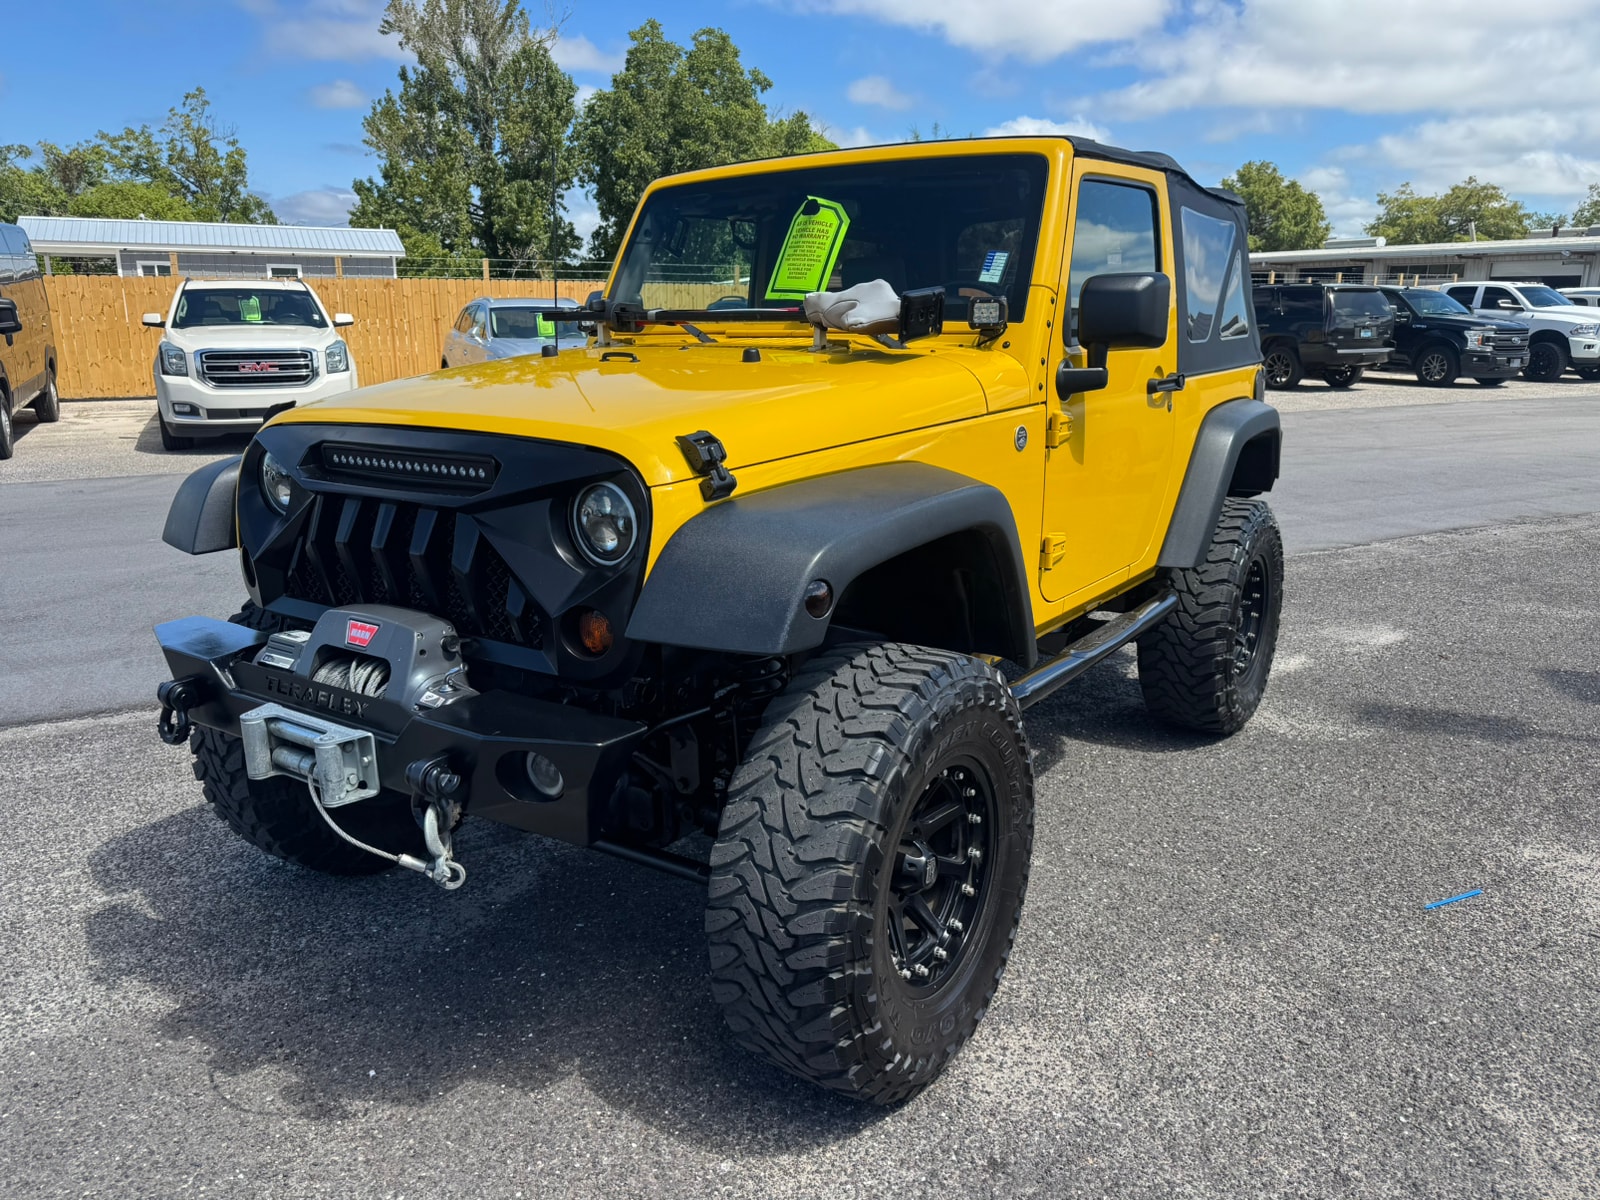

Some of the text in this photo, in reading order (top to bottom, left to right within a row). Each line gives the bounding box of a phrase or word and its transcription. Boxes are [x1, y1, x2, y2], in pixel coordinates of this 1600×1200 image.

[808, 220, 833, 228] VEHICLE
[239, 361, 279, 372] GMC
[350, 625, 371, 640] WARN
[265, 675, 369, 718] TERAFLEX
[980, 720, 1025, 840] COUNTRY
